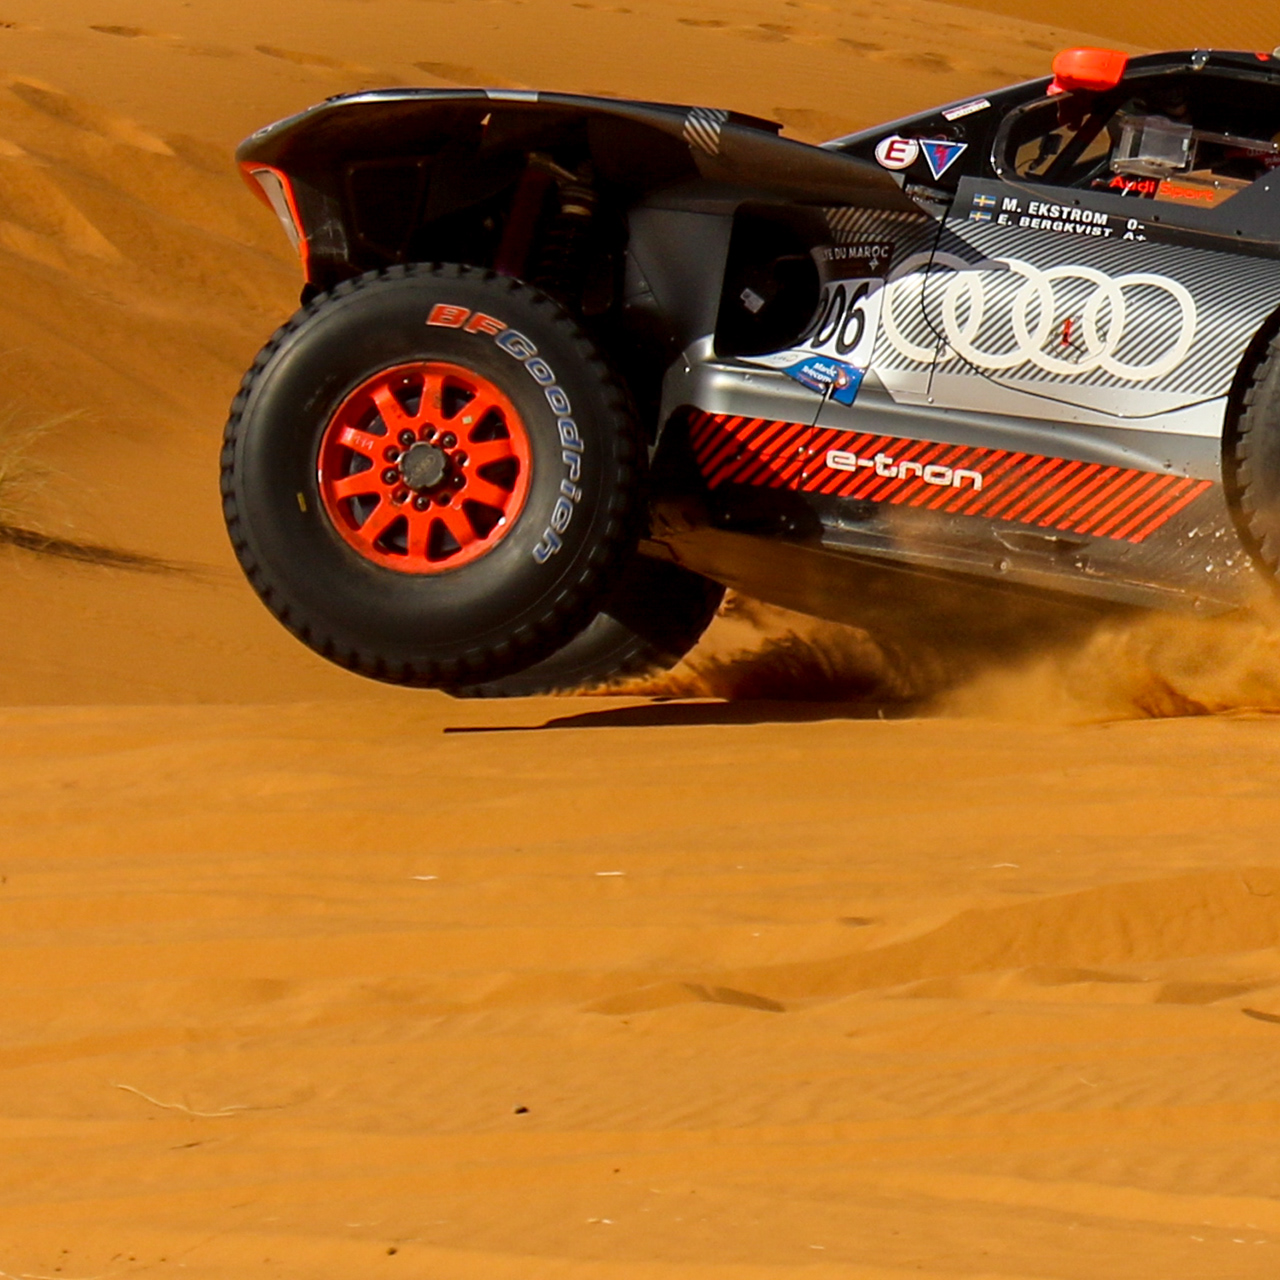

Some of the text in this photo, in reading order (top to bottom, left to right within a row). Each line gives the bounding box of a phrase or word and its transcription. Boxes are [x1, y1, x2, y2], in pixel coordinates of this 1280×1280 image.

[884, 139, 911, 163] E
[1109, 176, 1214, 202] Audi Sport
[1001, 197, 1022, 213] M.
[1028, 201, 1108, 226] EKSTROM
[996, 214, 1013, 227] E.
[1019, 216, 1113, 238] BERGKVIST
[425, 303, 585, 564] BFGoodrich
[826, 450, 982, 491] e-tron
